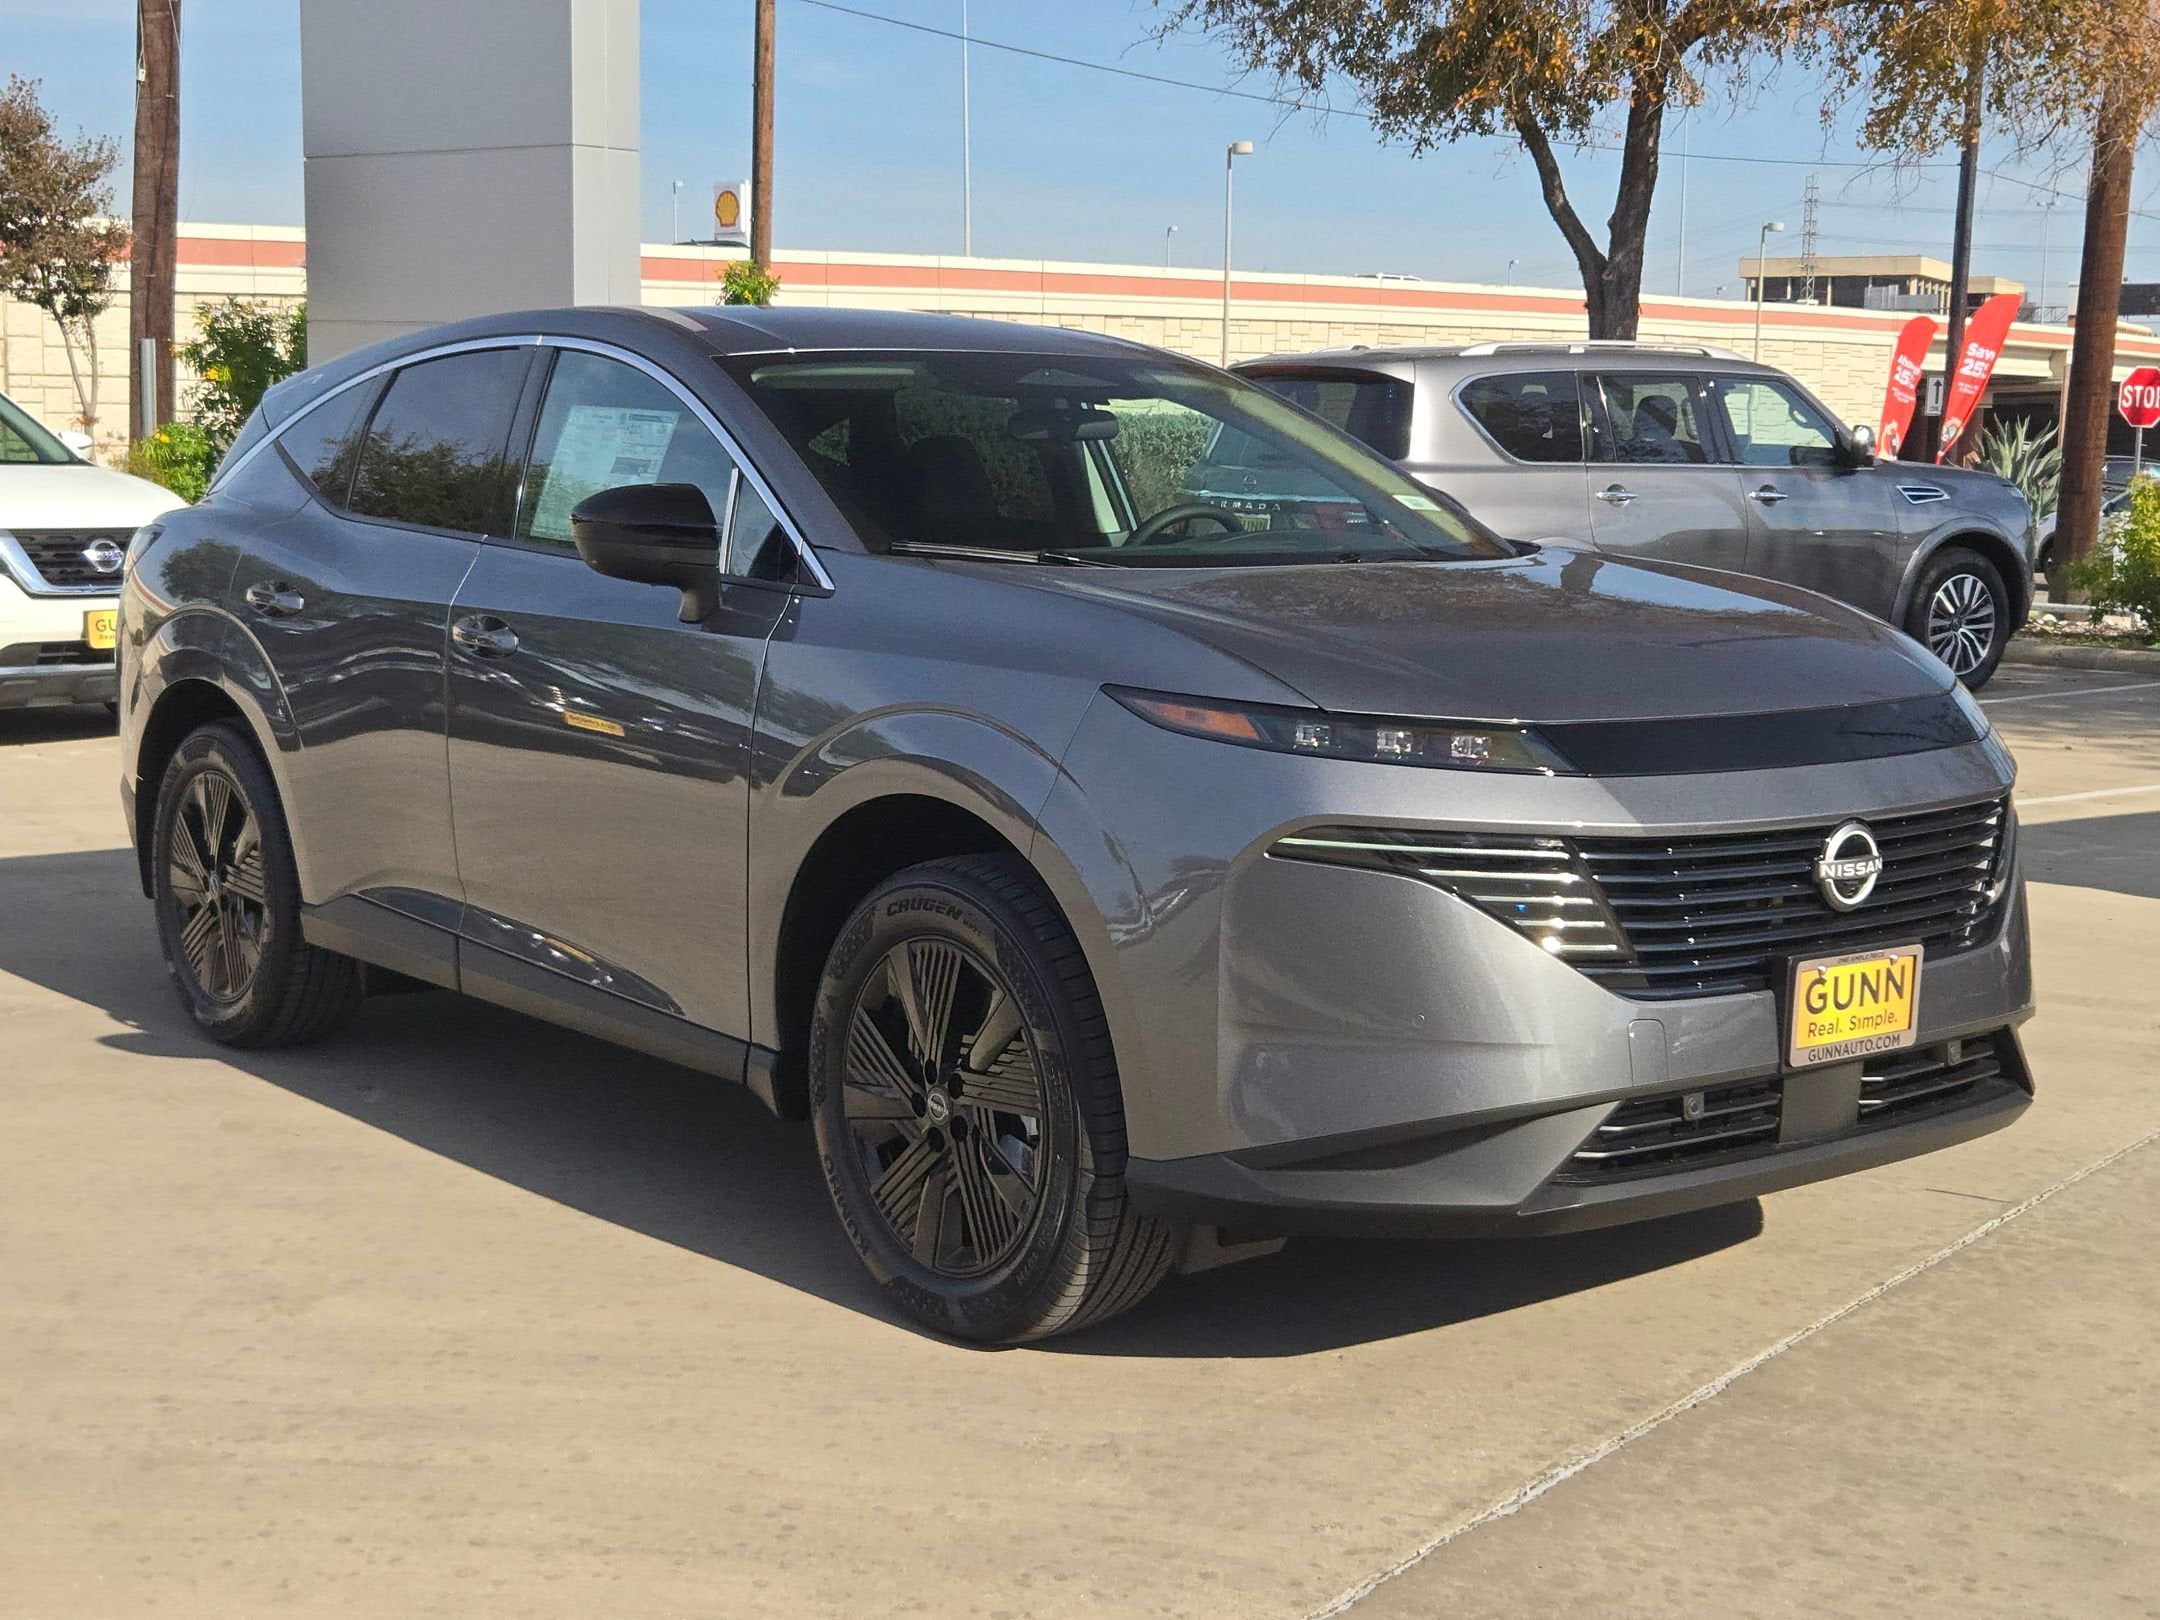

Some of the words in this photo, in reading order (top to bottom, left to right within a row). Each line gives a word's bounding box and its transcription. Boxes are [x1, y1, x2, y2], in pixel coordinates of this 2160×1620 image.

[1820, 857, 1882, 880] NISSAN
[1805, 965, 1906, 1015] GUNN
[1807, 1017, 1842, 1038] Real.
[1808, 1033, 1900, 1062] GUNNAUTO.COM
